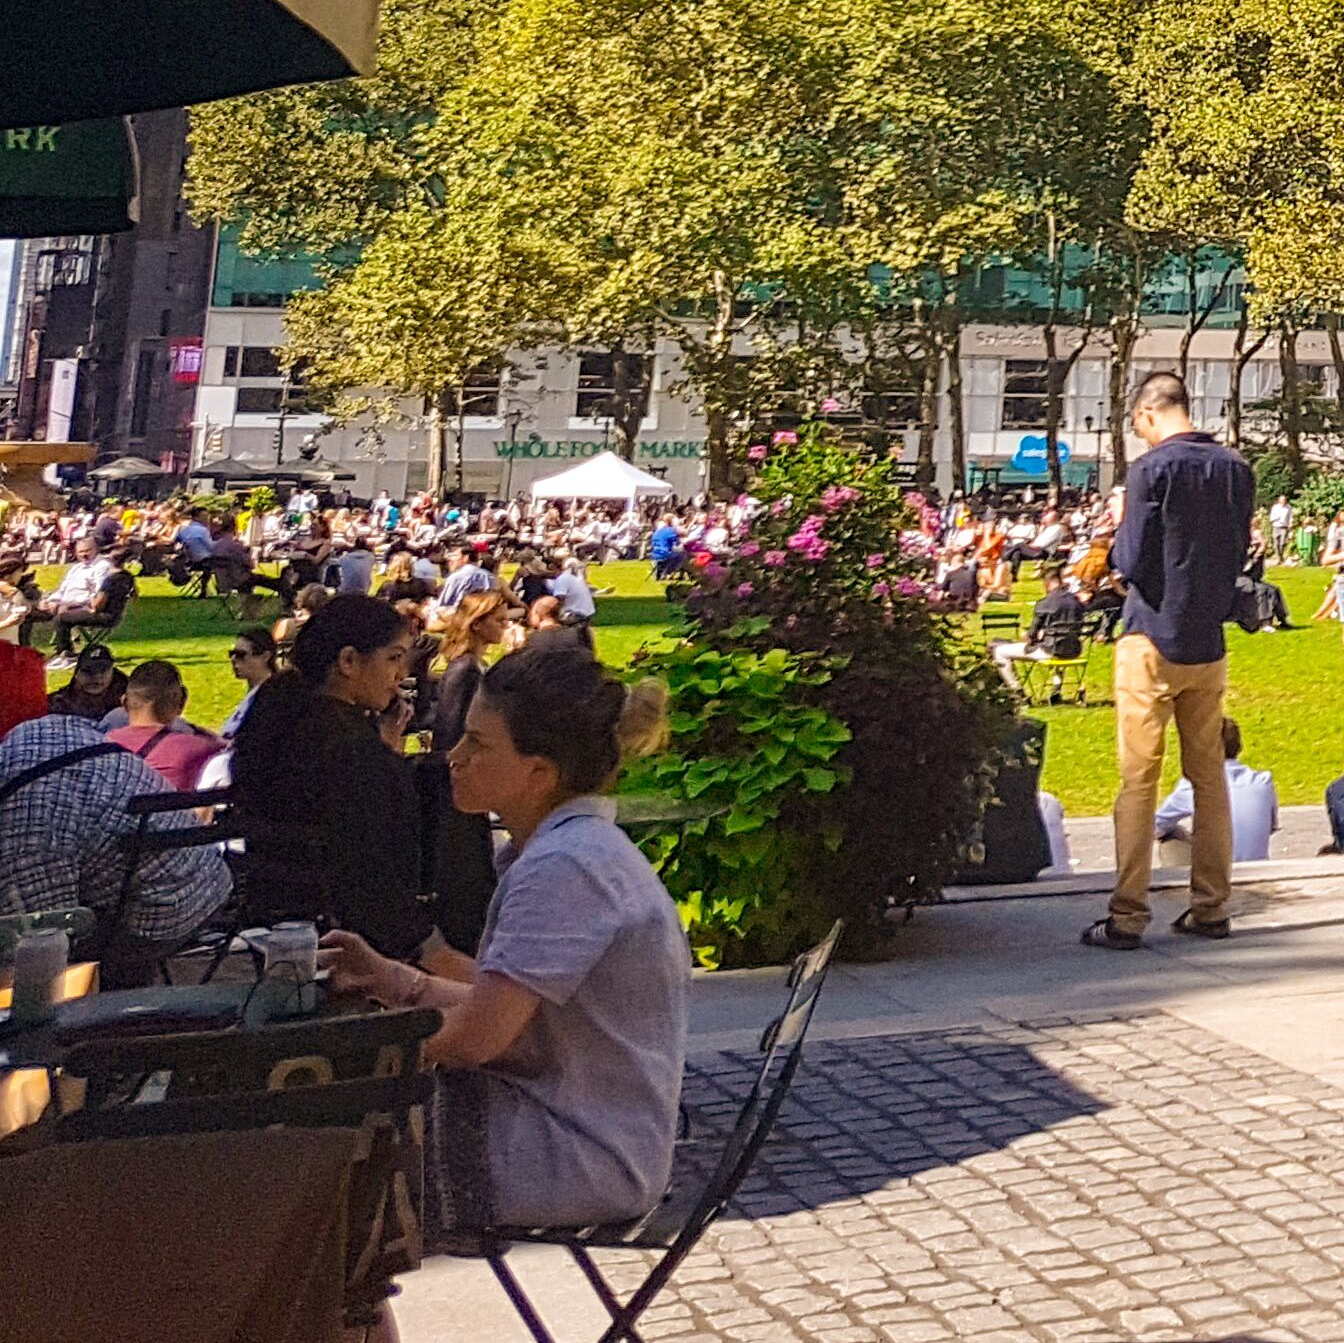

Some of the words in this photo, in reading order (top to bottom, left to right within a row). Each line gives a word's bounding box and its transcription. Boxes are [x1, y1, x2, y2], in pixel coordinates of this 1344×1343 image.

[4, 126, 61, 151] RK
[493, 440, 568, 458] WHOLE
[640, 441, 701, 458] MARK
